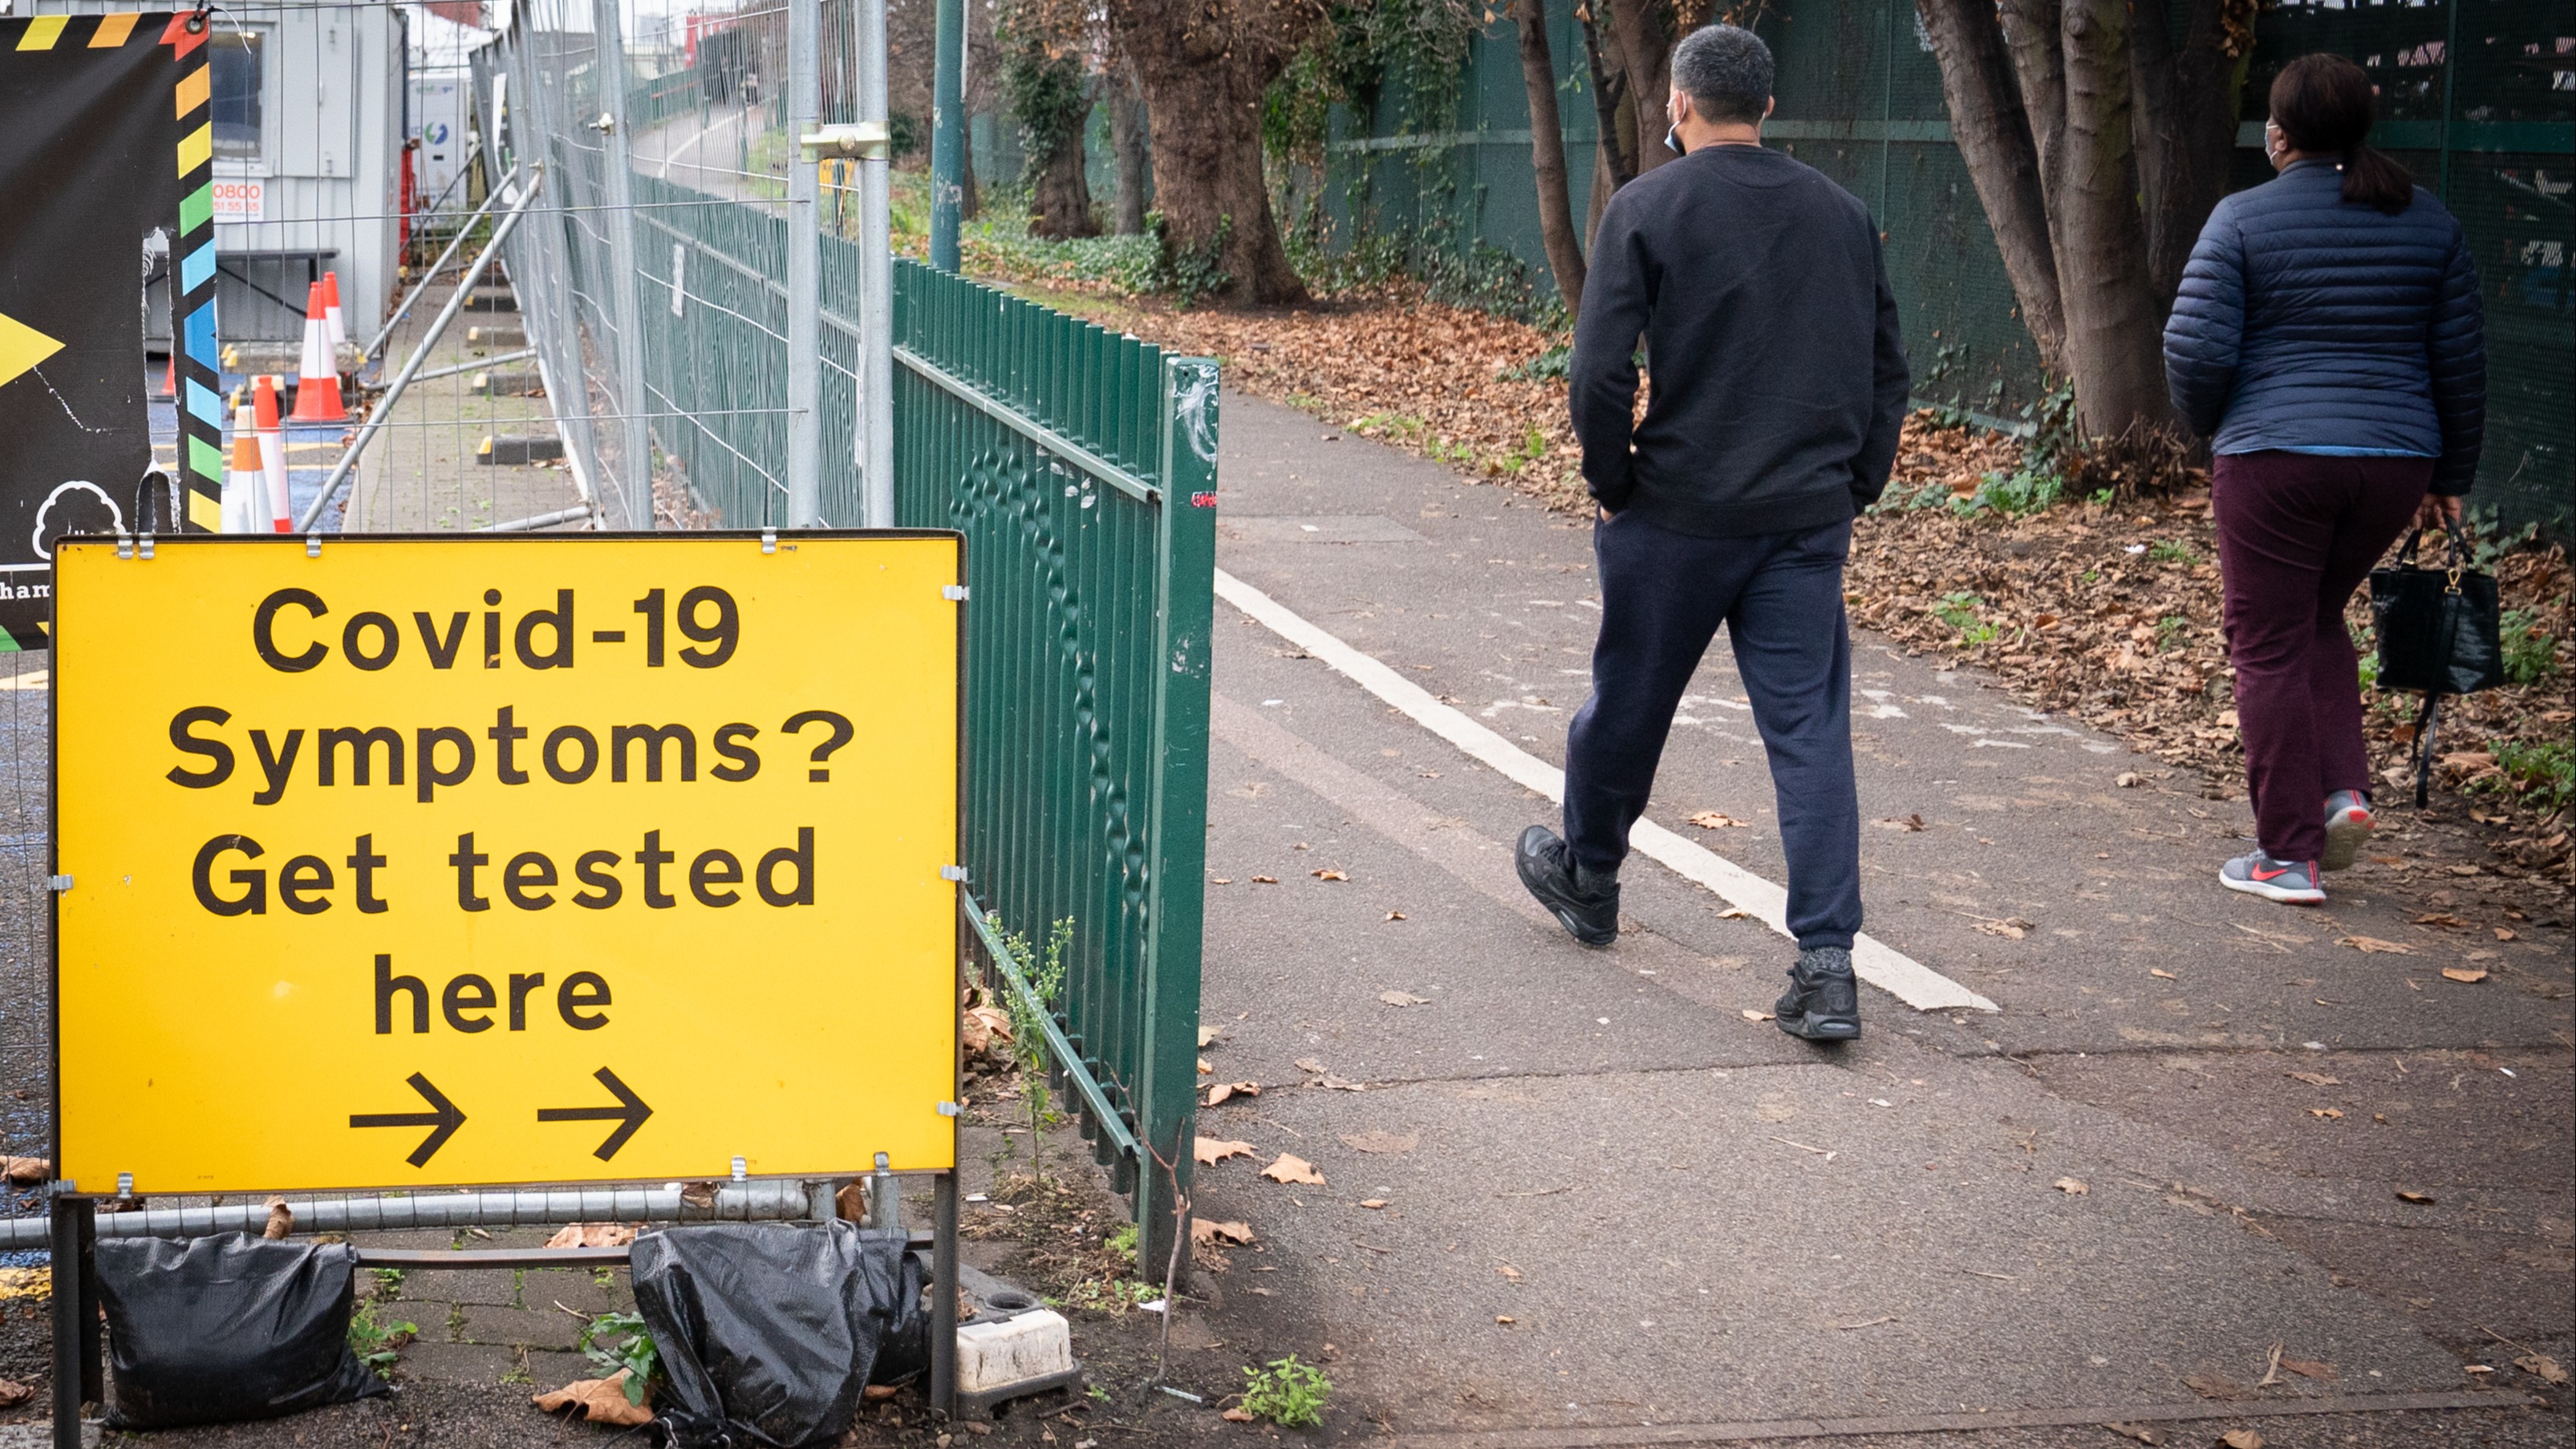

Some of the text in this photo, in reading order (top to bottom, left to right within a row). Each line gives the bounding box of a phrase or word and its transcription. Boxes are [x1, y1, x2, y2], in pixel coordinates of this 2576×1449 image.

[213, 185, 260, 199] 0800
[253, 586, 740, 673] Covid-19
[165, 706, 854, 806] Symptoms?
[192, 826, 814, 917] Get tested
[375, 954, 612, 1035] here
